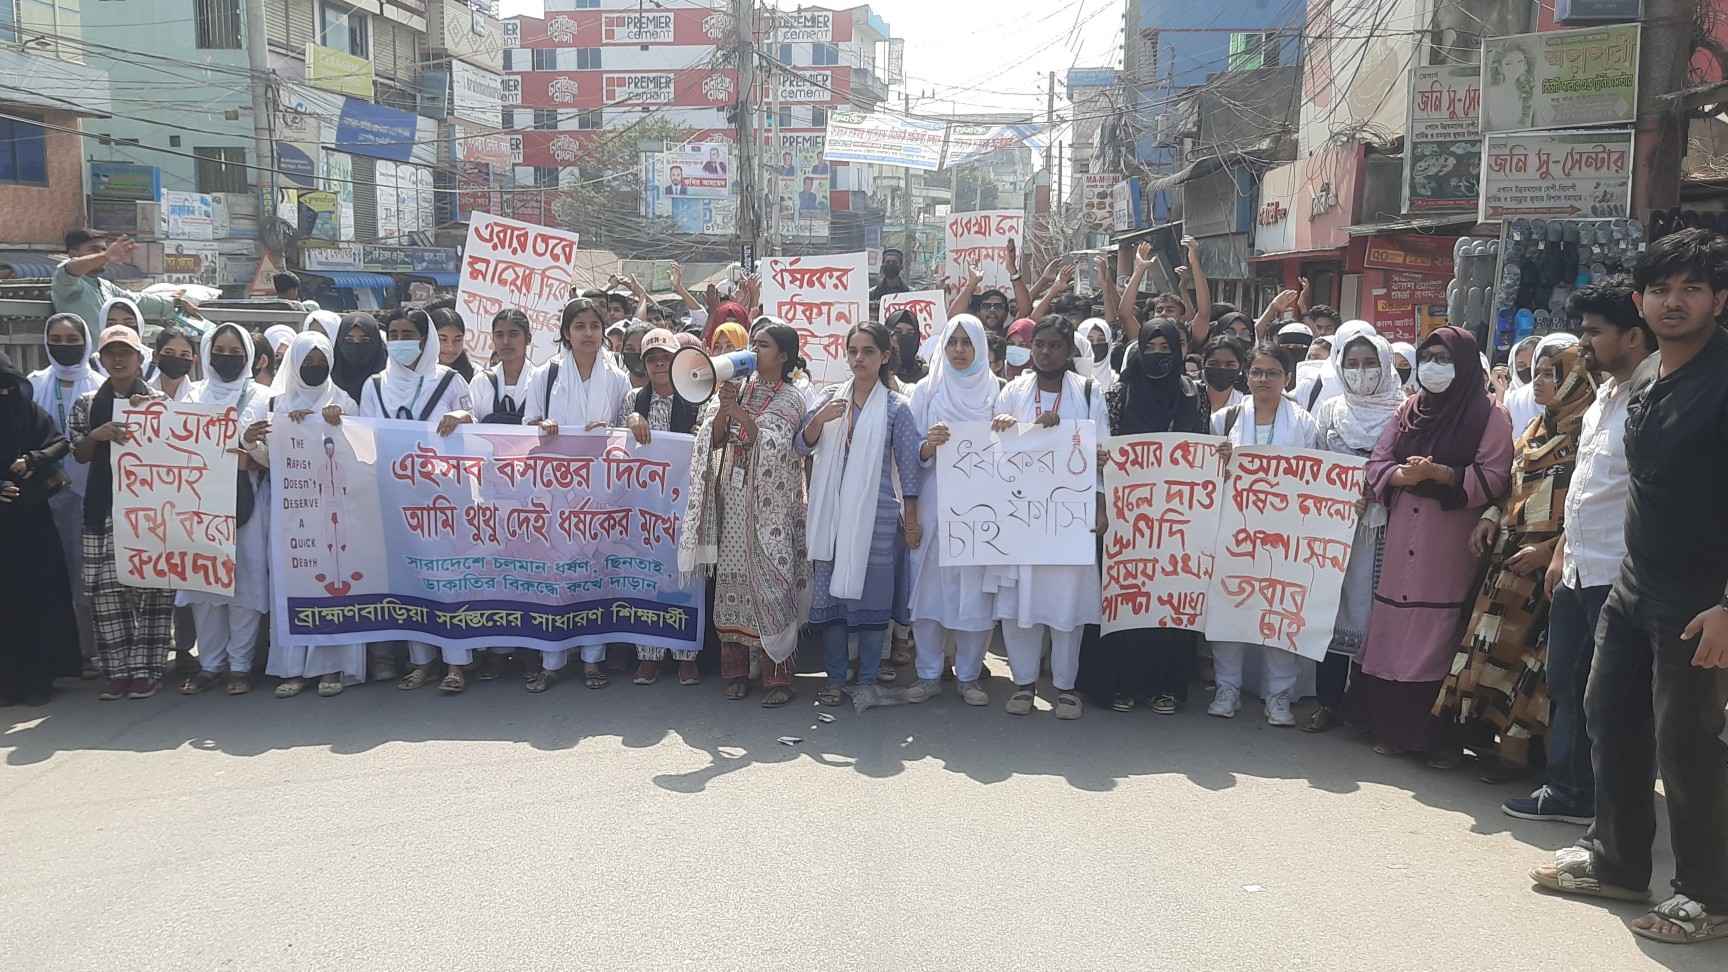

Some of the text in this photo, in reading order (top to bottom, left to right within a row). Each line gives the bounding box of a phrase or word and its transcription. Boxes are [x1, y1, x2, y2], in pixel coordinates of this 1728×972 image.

[626, 15, 672, 29] PREMIER
[627, 30, 672, 39] cement
[783, 29, 830, 40] cement
[627, 76, 672, 90] PREMIER
[780, 89, 826, 99] cement
[783, 73, 829, 88] PREMIER
[1417, 80, 1442, 114] জনি
[1488, 144, 1528, 177] জনি
[533, 232, 576, 266] তবে
[118, 442, 208, 500] ছিনতাই
[392, 441, 681, 503] এইসব বসন্তের দিনে,
[952, 439, 1056, 483] ধর্ষকের
[1237, 452, 1324, 485] আমার
[1163, 479, 1217, 511] দাও
[298, 518, 305, 529] A
[401, 495, 681, 549] আমি থুথু দেই ধর্ষকের মুখে
[946, 485, 1093, 560] চাই ফাঁসি
[405, 555, 486, 572] সারাদেশে
[492, 557, 547, 574] চলমান
[1104, 550, 1216, 591] সময় এখন
[422, 573, 496, 593] ডাকাতির
[566, 577, 603, 593] রুখে
[295, 597, 429, 627] ব্রাহ্মণবাড়িয়া
[435, 603, 522, 631] সর্বস্তরের
[530, 606, 605, 633] সাধারণ
[1258, 607, 1306, 651] চাই
